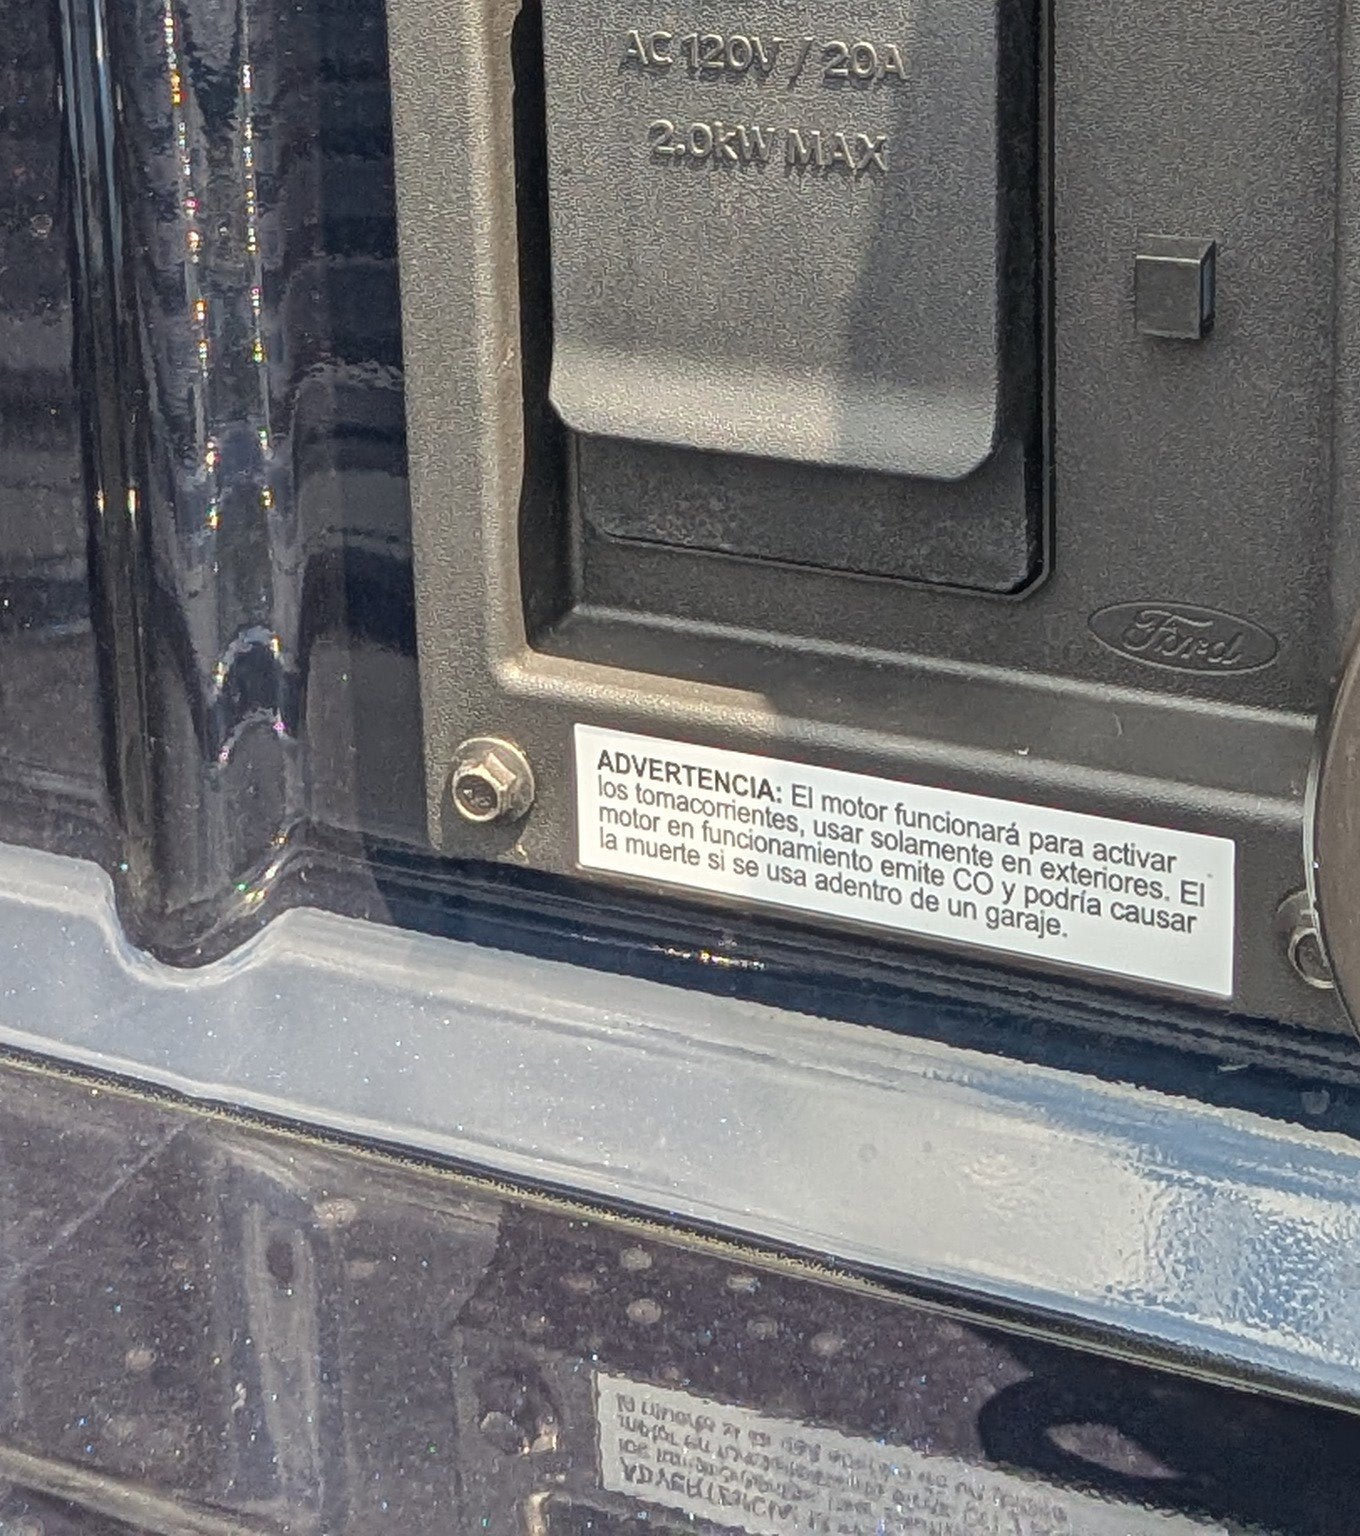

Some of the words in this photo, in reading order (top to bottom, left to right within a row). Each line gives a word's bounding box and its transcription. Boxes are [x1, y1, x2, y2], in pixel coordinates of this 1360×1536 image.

[621, 29, 674, 68] AC
[681, 32, 782, 71] 120V
[822, 41, 909, 80] 20A
[648, 119, 775, 165] 2.0kW
[788, 129, 888, 170] MAX
[1123, 609, 1243, 665] Ford
[598, 750, 782, 804] ADVERTENCIA:
[792, 784, 812, 809] El
[822, 795, 888, 822] motor
[894, 802, 1020, 846] funcionará
[1030, 832, 1084, 858] para
[1093, 843, 1177, 873] activar
[598, 774, 628, 800] los
[635, 783, 804, 838] tomacorrientes,
[814, 820, 864, 844] usar
[871, 830, 993, 868] solamente
[1002, 854, 1032, 876] en
[1040, 862, 1170, 902] exteriores.
[1181, 880, 1204, 907] El
[600, 806, 660, 832] motor
[668, 820, 694, 839] en
[702, 820, 873, 873] funcionamiento
[881, 859, 945, 886] emite
[953, 868, 994, 895] CO
[1002, 881, 1016, 904] y
[1024, 885, 1101, 916] podría
[1110, 902, 1197, 934] causar
[600, 826, 617, 850] la
[626, 838, 700, 866] muerte
[708, 850, 724, 871] si
[733, 858, 759, 877] se
[767, 864, 806, 887] usa
[815, 872, 902, 905] adentro
[910, 887, 940, 912] de
[948, 898, 977, 920] un
[985, 903, 1068, 938] garaje.
